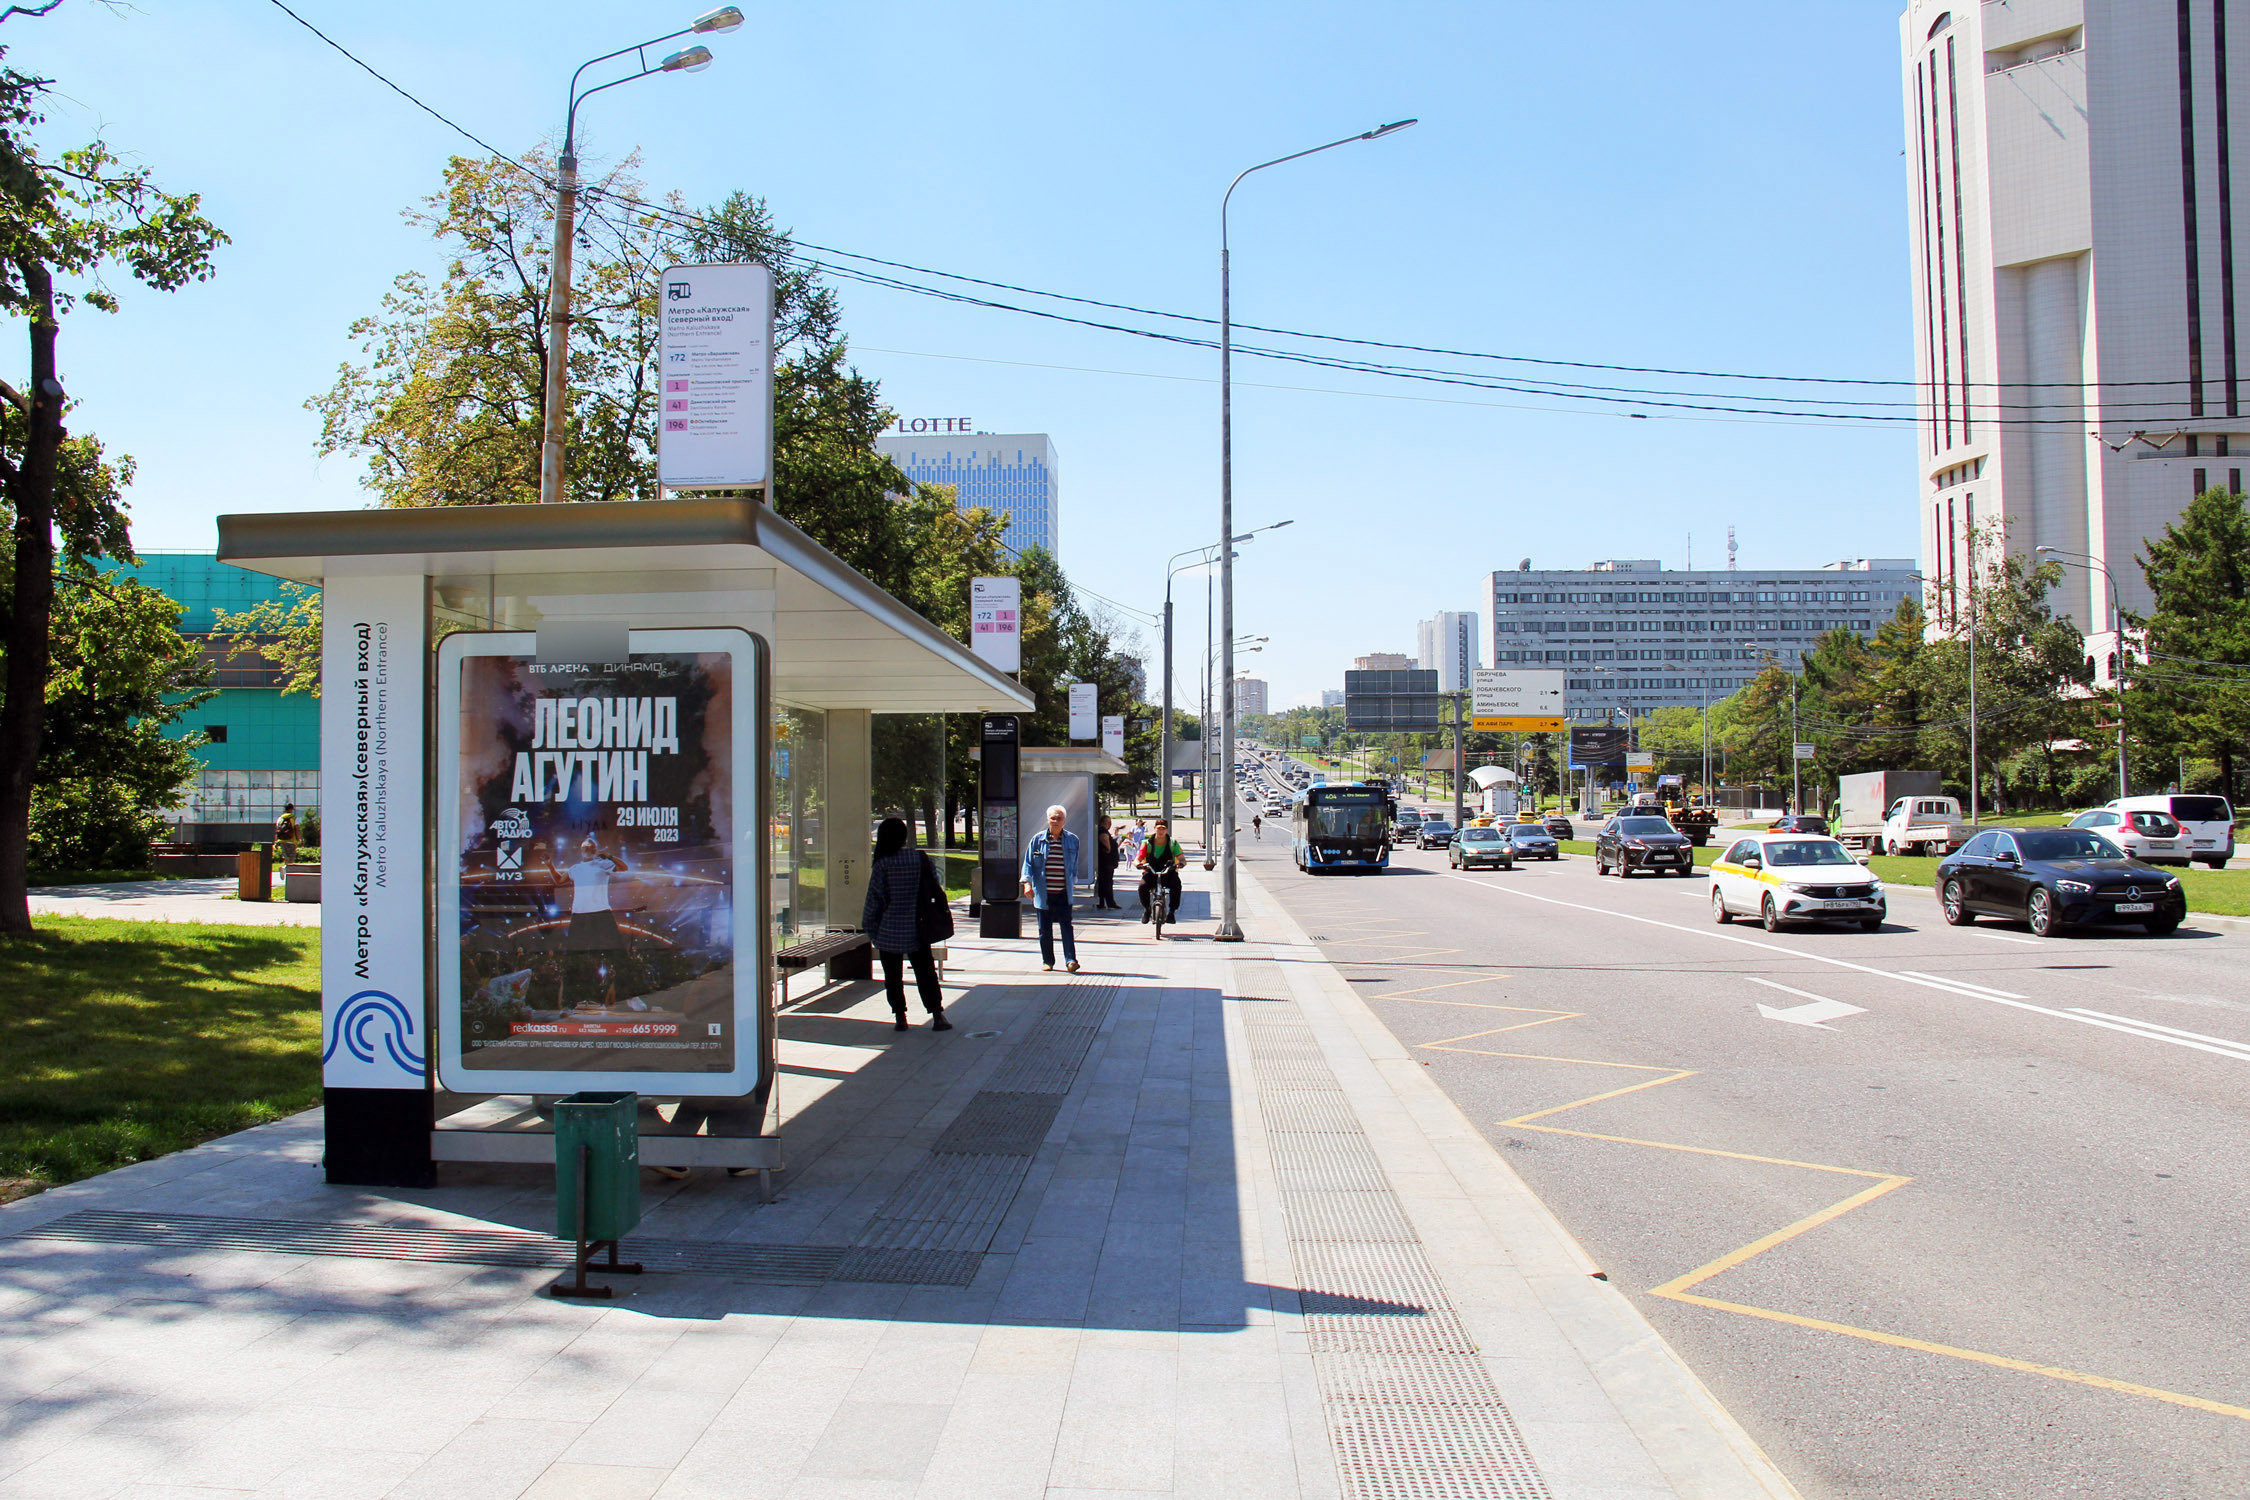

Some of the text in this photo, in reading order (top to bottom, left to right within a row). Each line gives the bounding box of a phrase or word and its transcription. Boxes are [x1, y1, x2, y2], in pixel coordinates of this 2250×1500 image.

[668, 306, 750, 315] Метро «Калужская»
[668, 314, 734, 324] (северный вход)
[670, 353, 686, 362] т72
[674, 382, 680, 390] 1
[672, 401, 682, 409] 41
[668, 421, 684, 429] 196
[899, 417, 972, 433] LOTTE
[1003, 611, 1008, 619] 1
[999, 623, 1013, 631] 196
[352, 622, 371, 671] вход)
[529, 663, 590, 674] ВТБ АРЕНА
[603, 662, 662, 674] ДИНАМО
[531, 697, 679, 755] ЛЕОНИД
[374, 622, 389, 888] Metro Kaluzhskaya (Northern Entrance)
[511, 751, 648, 802] АГУТИН
[617, 807, 679, 827] 29 ИЮЛЯ
[489, 820, 518, 830] АВТО
[497, 829, 533, 838] РАДИО
[654, 828, 679, 842] 2023
[496, 872, 523, 881] МУЗ
[354, 914, 371, 980] Метро
[513, 1023, 567, 1033] redkassa.ru
[652, 1025, 677, 1034] 9999
